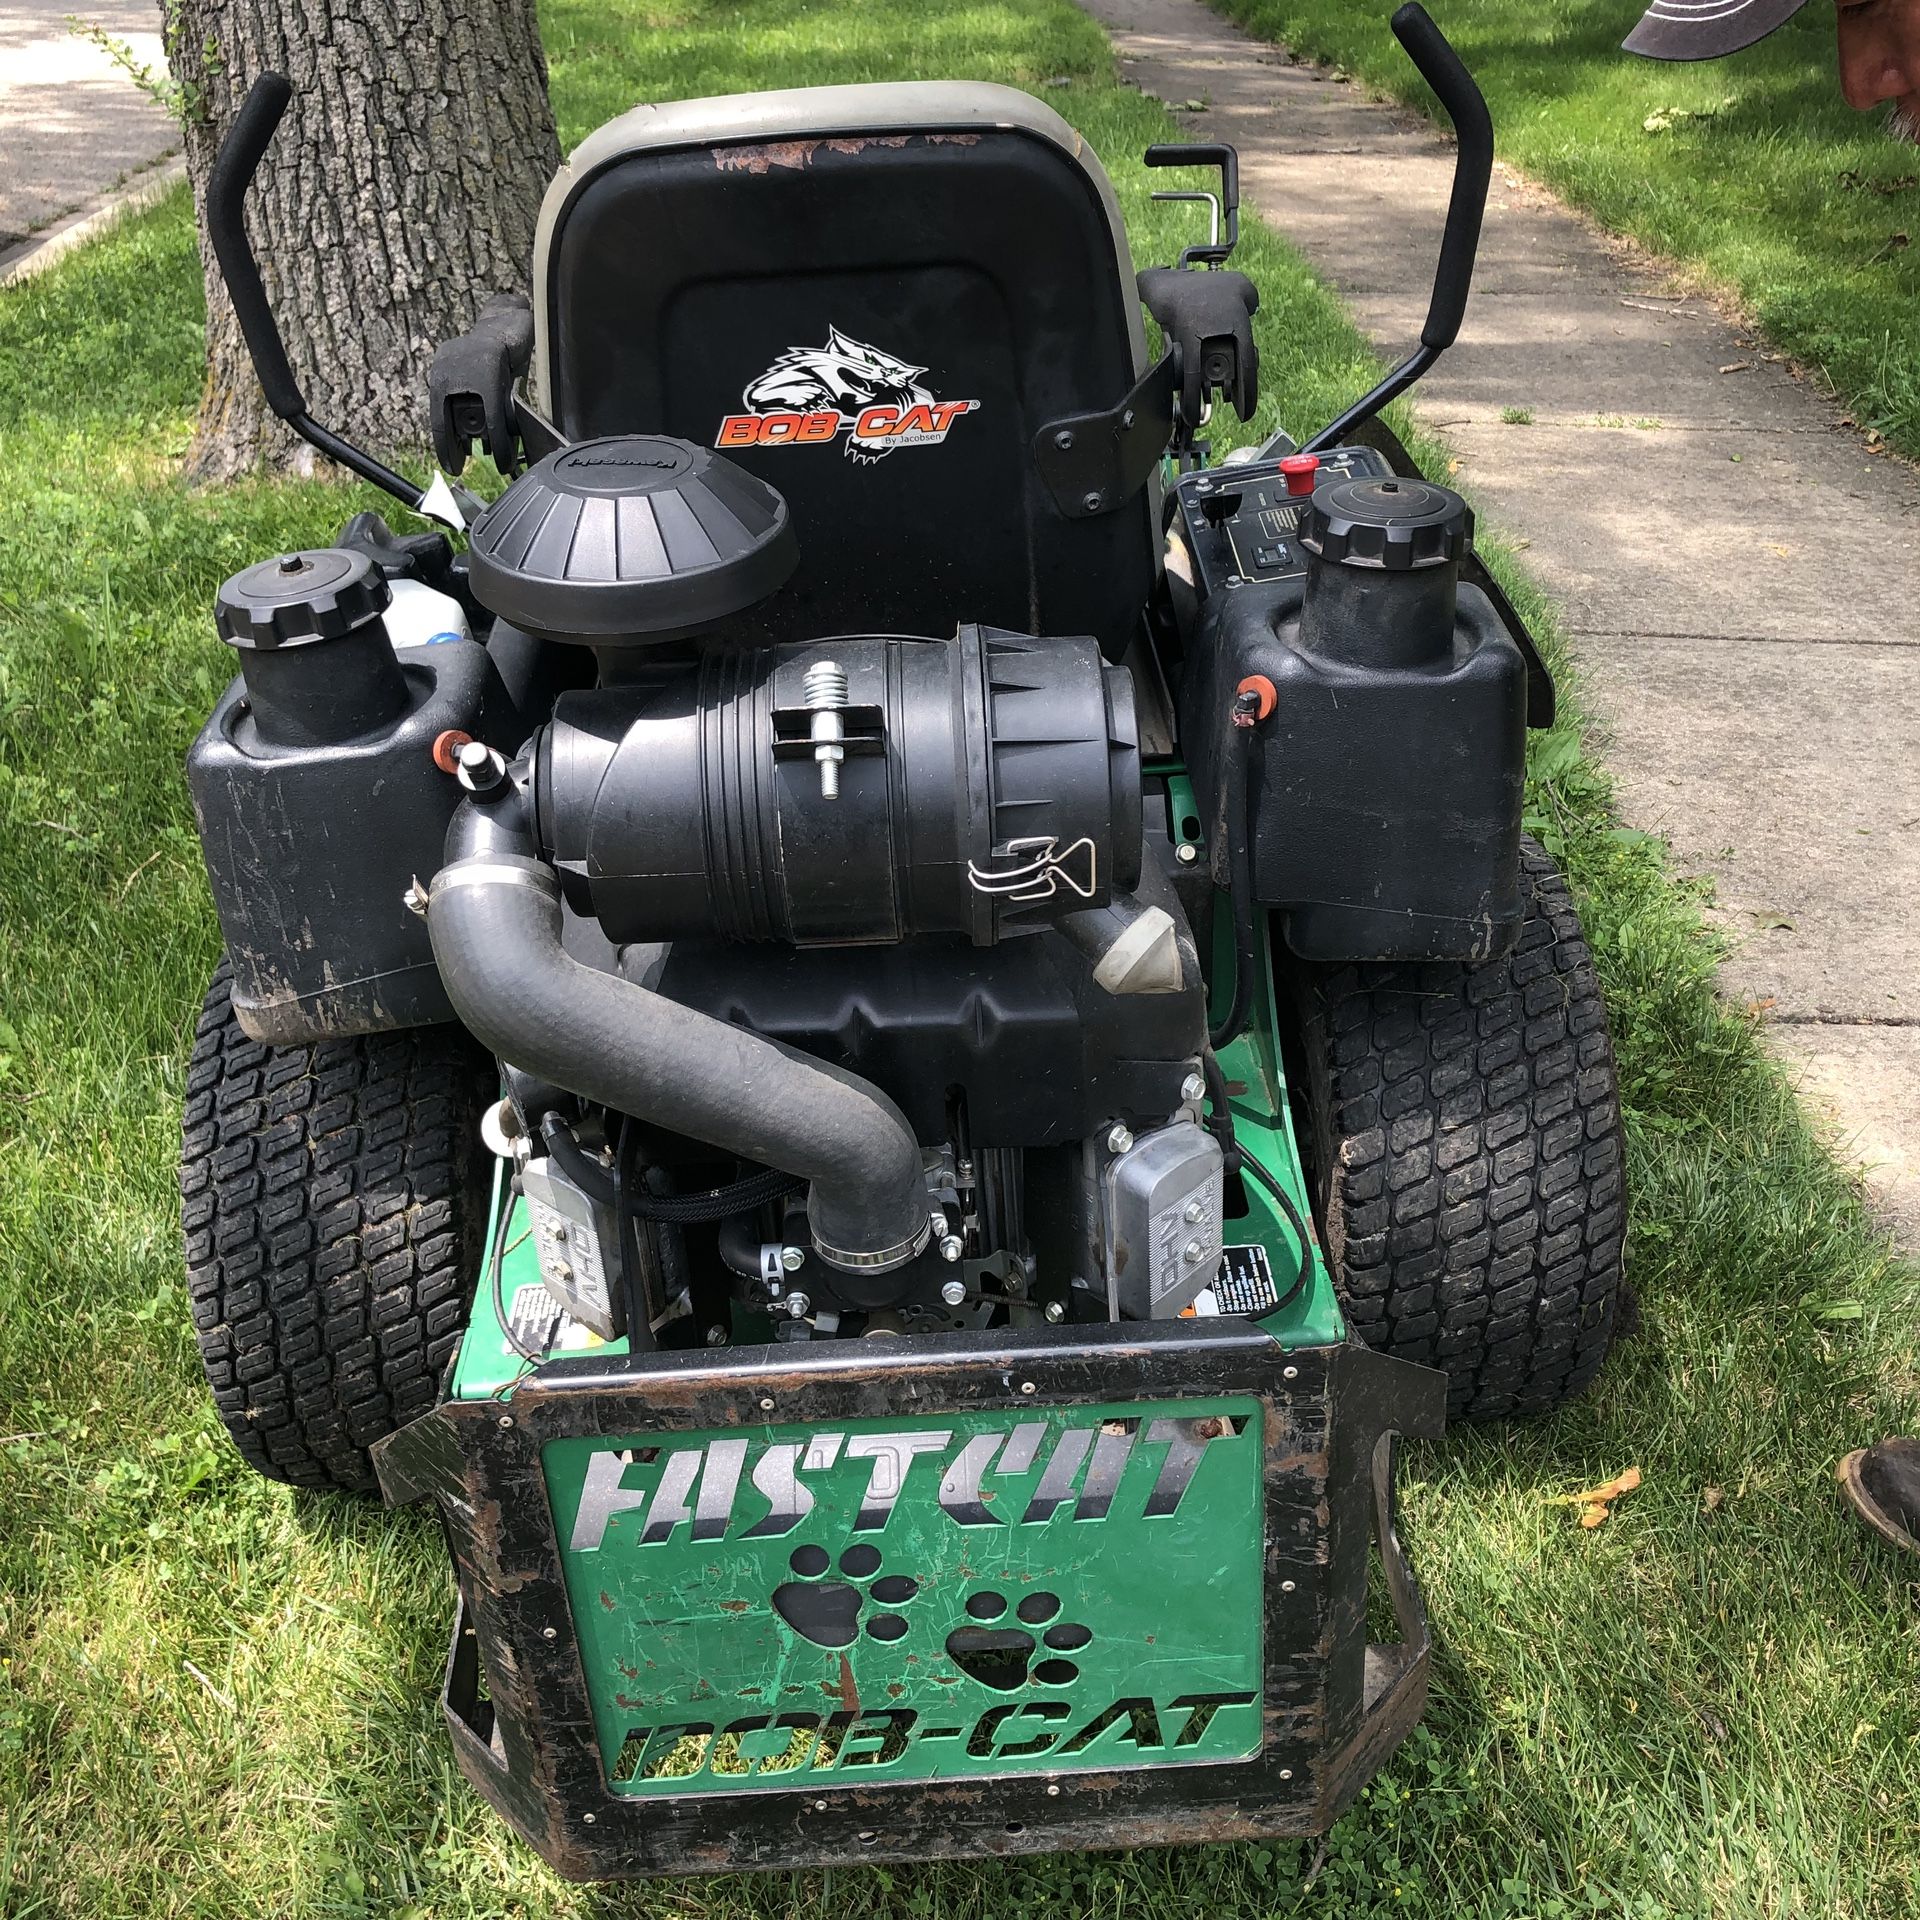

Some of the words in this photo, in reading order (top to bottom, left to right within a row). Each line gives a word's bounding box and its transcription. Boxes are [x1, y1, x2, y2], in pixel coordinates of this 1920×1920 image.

[884, 436, 897, 445] By
[899, 433, 942, 444] Jacobsen
[570, 1221, 602, 1308] OHV
[1160, 1211, 1179, 1293] OHV
[569, 1416, 1253, 1552] FASTCAT
[608, 1692, 1260, 1784] BOB-CAT
